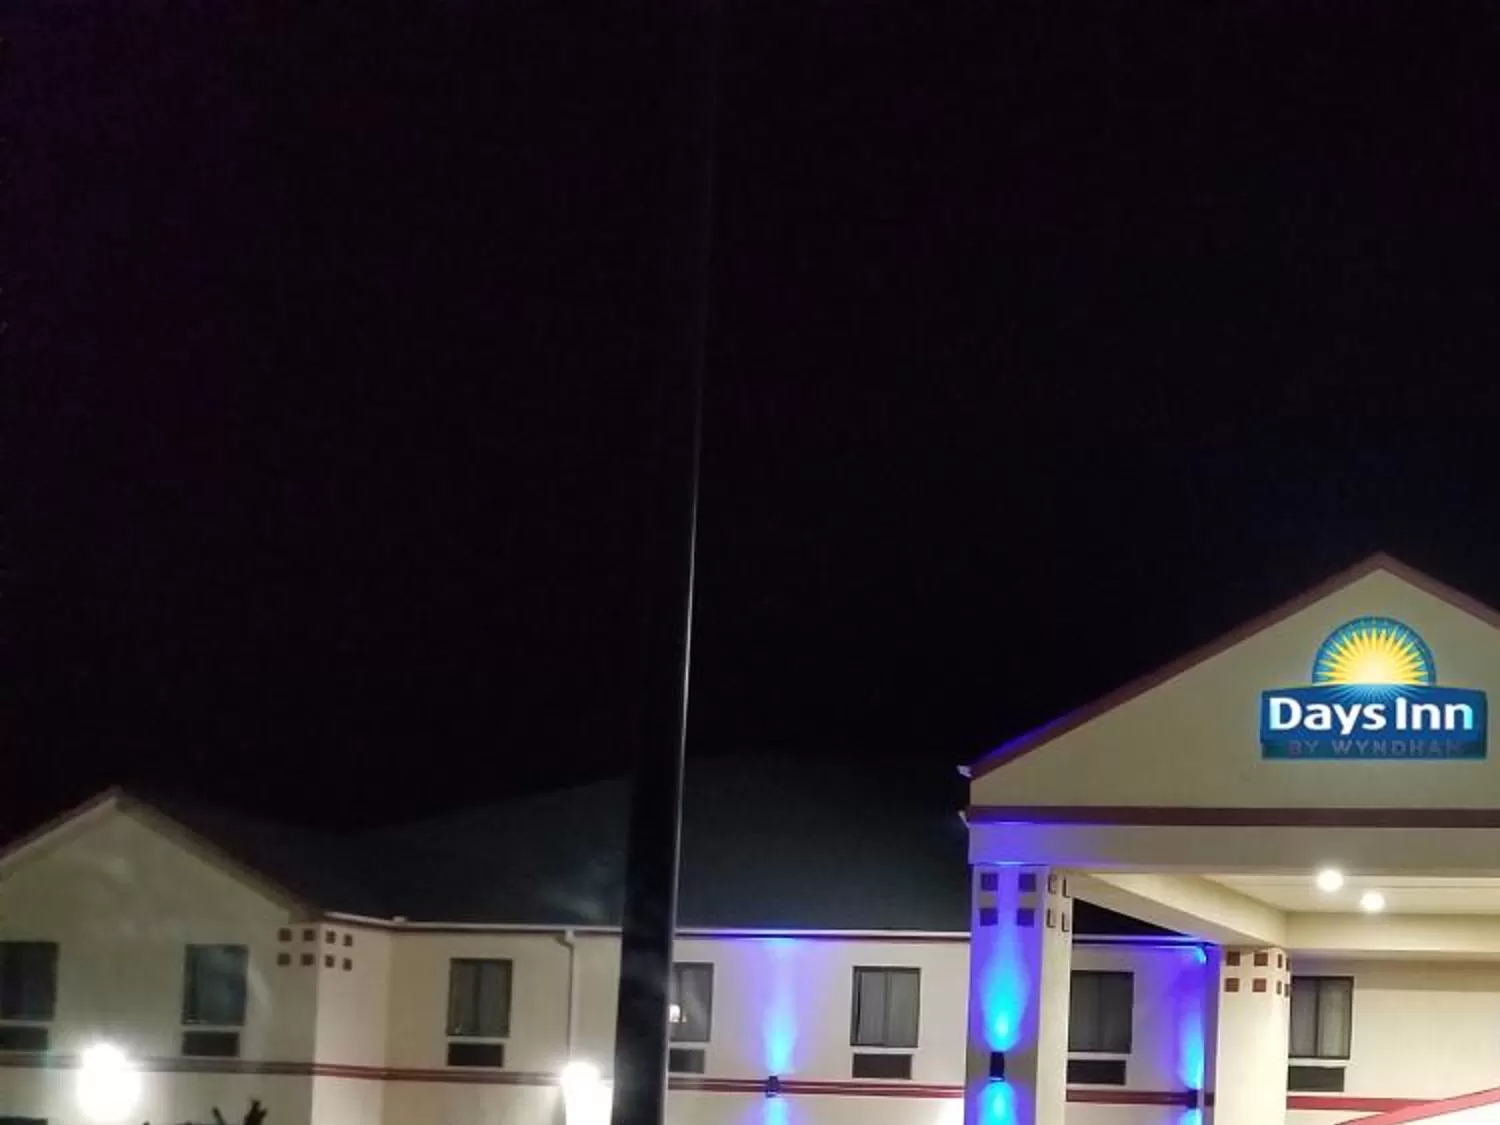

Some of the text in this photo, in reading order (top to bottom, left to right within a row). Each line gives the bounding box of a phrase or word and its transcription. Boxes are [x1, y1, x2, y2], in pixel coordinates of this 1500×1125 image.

[1269, 697, 1473, 735] Days Inn
[1287, 740, 1319, 757] BY
